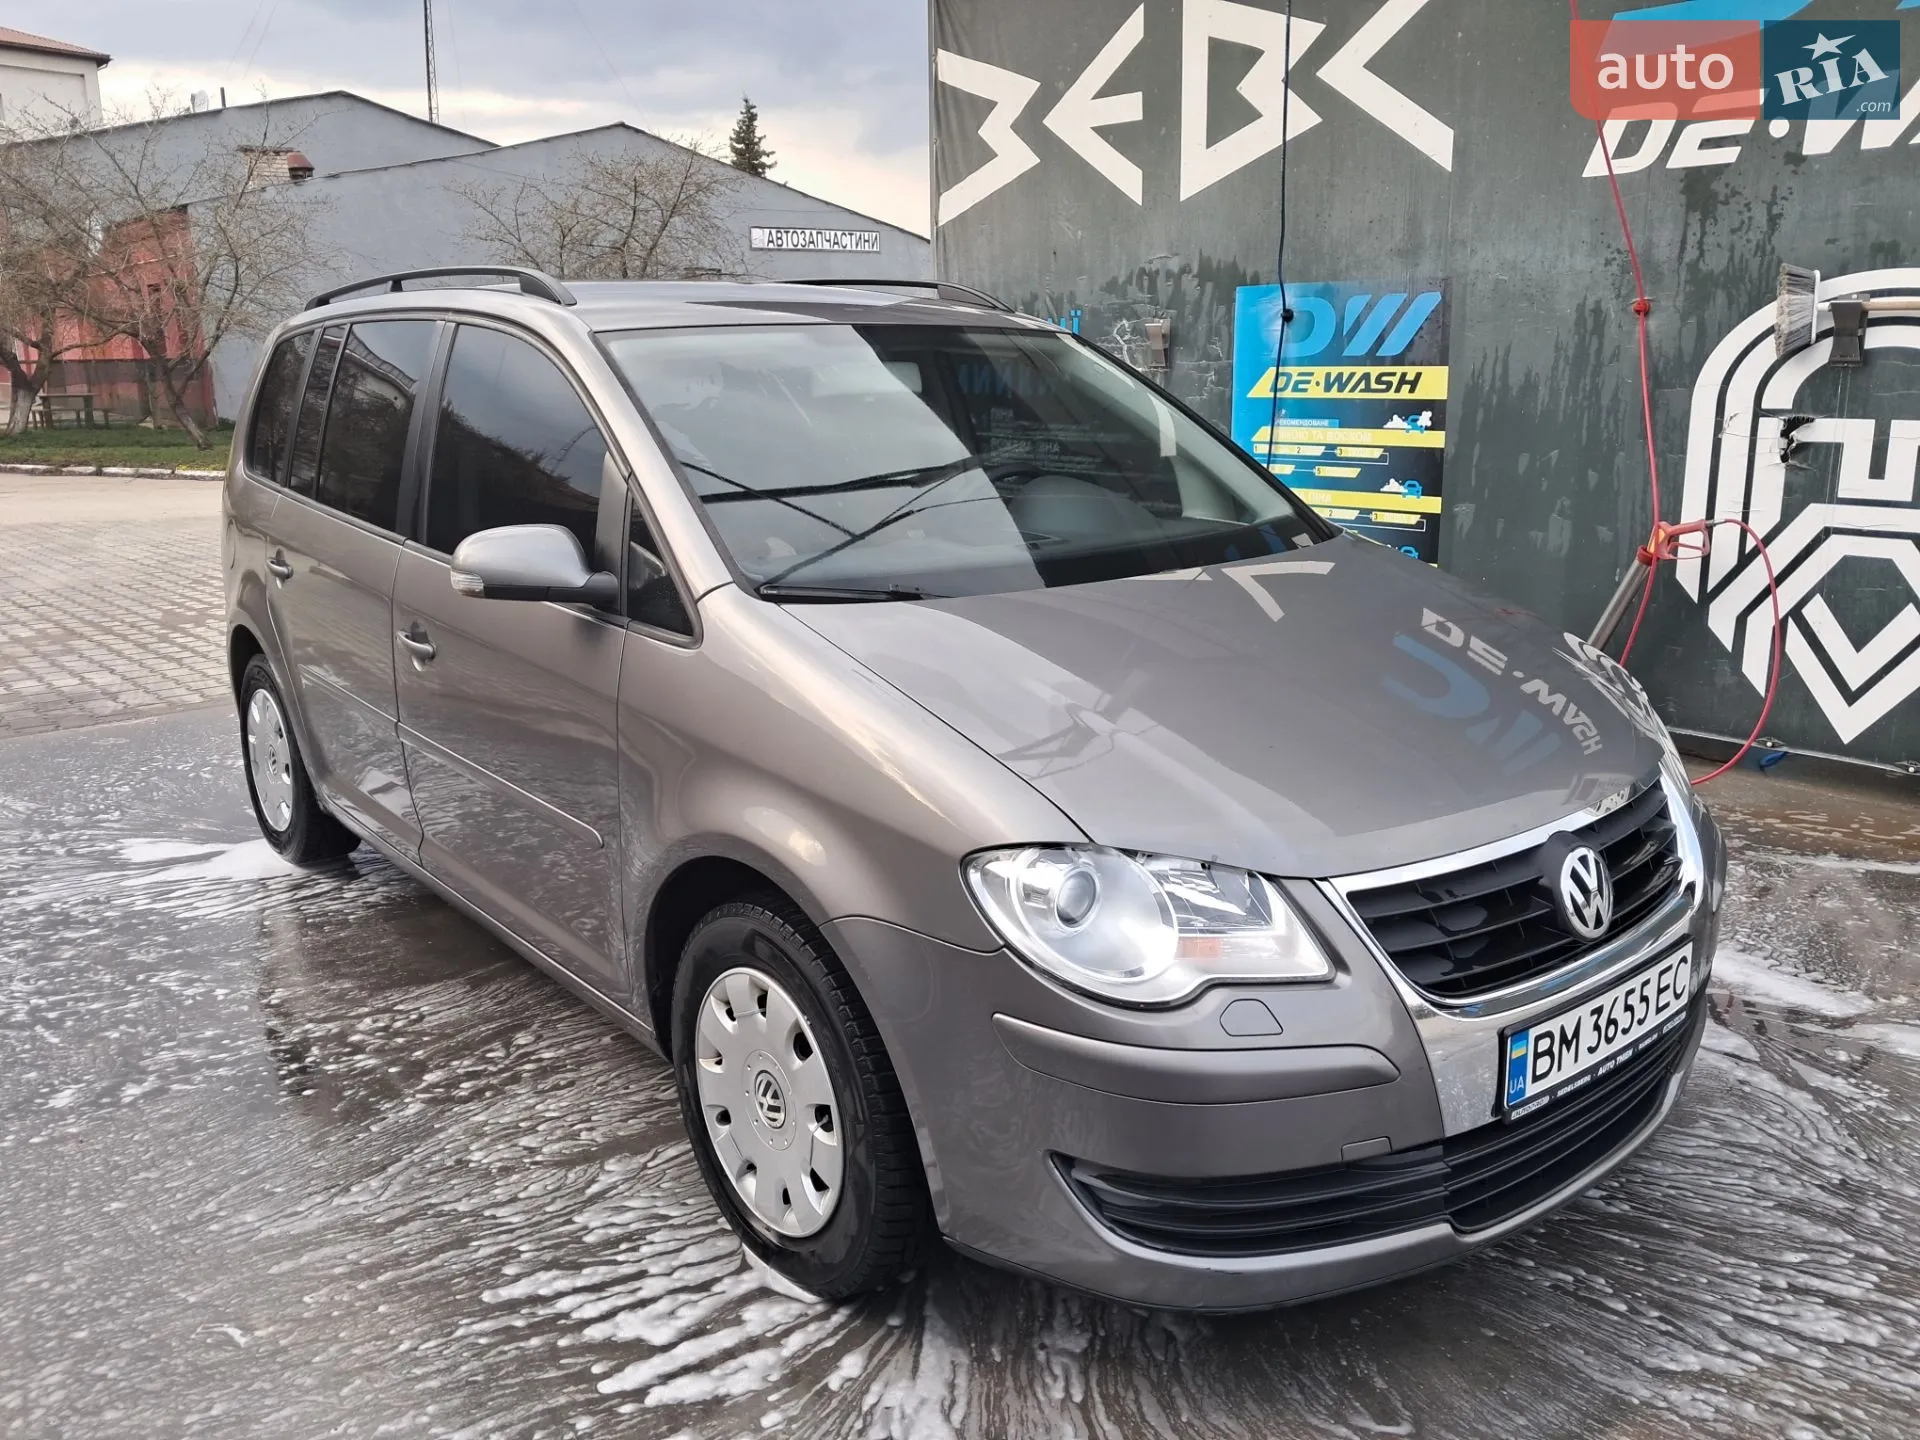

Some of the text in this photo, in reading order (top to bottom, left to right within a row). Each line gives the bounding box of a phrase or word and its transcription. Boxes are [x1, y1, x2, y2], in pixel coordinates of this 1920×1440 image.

[766, 229, 879, 250] АВТОЗАПЧАСТИНИ
[1531, 955, 1689, 1085] BM 3655 EC
[1509, 1075, 1525, 1094] UA
